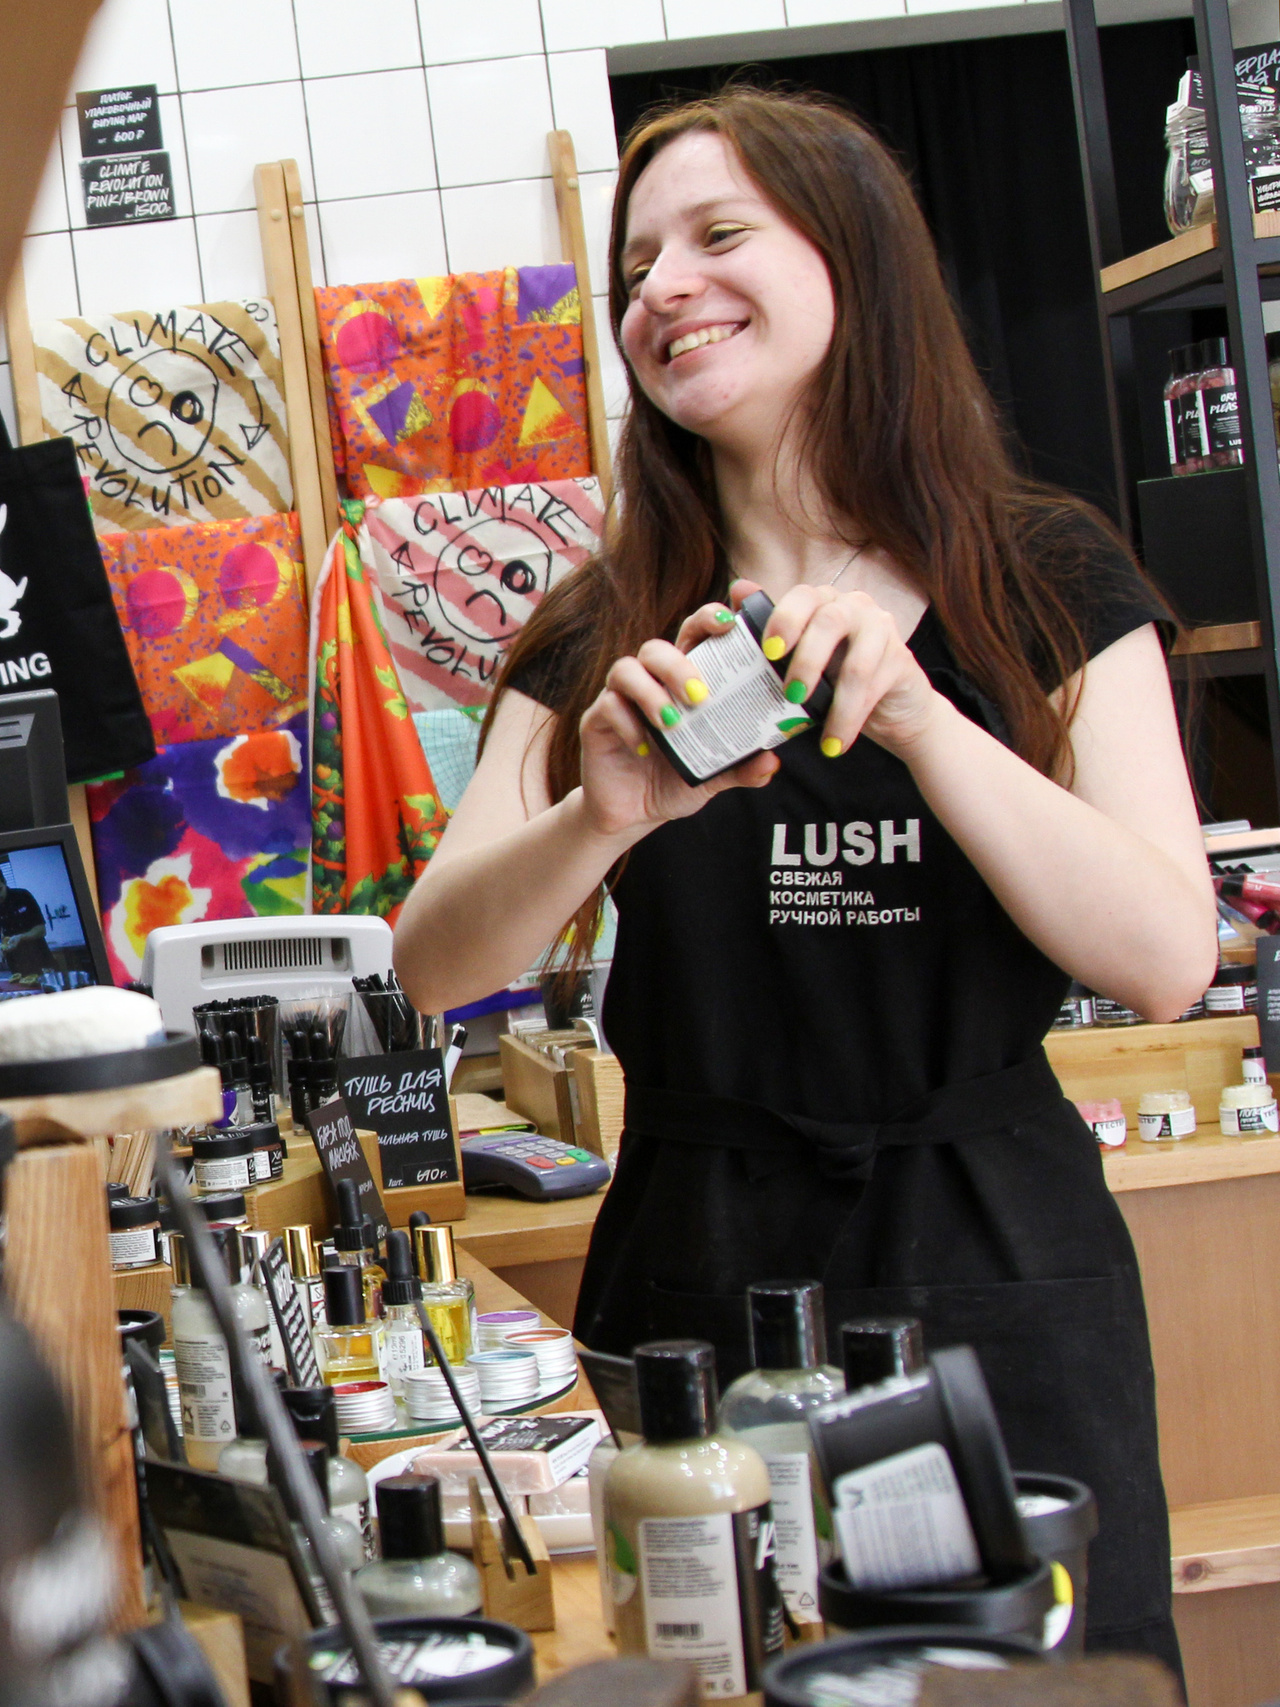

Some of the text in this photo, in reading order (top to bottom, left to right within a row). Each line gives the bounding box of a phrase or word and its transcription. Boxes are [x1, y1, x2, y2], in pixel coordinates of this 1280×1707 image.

[114, 131, 135, 143] 600
[99, 160, 151, 178] CLIMATE
[89, 174, 164, 194] REVOLUTION
[87, 187, 170, 208] PINK/BROWN
[86, 310, 259, 377] CLIMATE
[1210, 402, 1238, 415] PLEAS
[63, 413, 247, 515] REVOLUTION
[414, 484, 591, 547] CLIMATE
[391, 581, 500, 681] REVOLU
[771, 818, 920, 866] LUSH
[770, 871, 843, 886] СВЕЖАЯ
[770, 890, 875, 906] КОСМЕТИКА
[770, 907, 920, 925] РУЧНОЙ РАБОТЫ
[344, 1068, 442, 1096] ТУШЬ ДЛЯ
[367, 1092, 436, 1116] РЕСНИЦ
[422, 1129, 448, 1142] ТУШЬ
